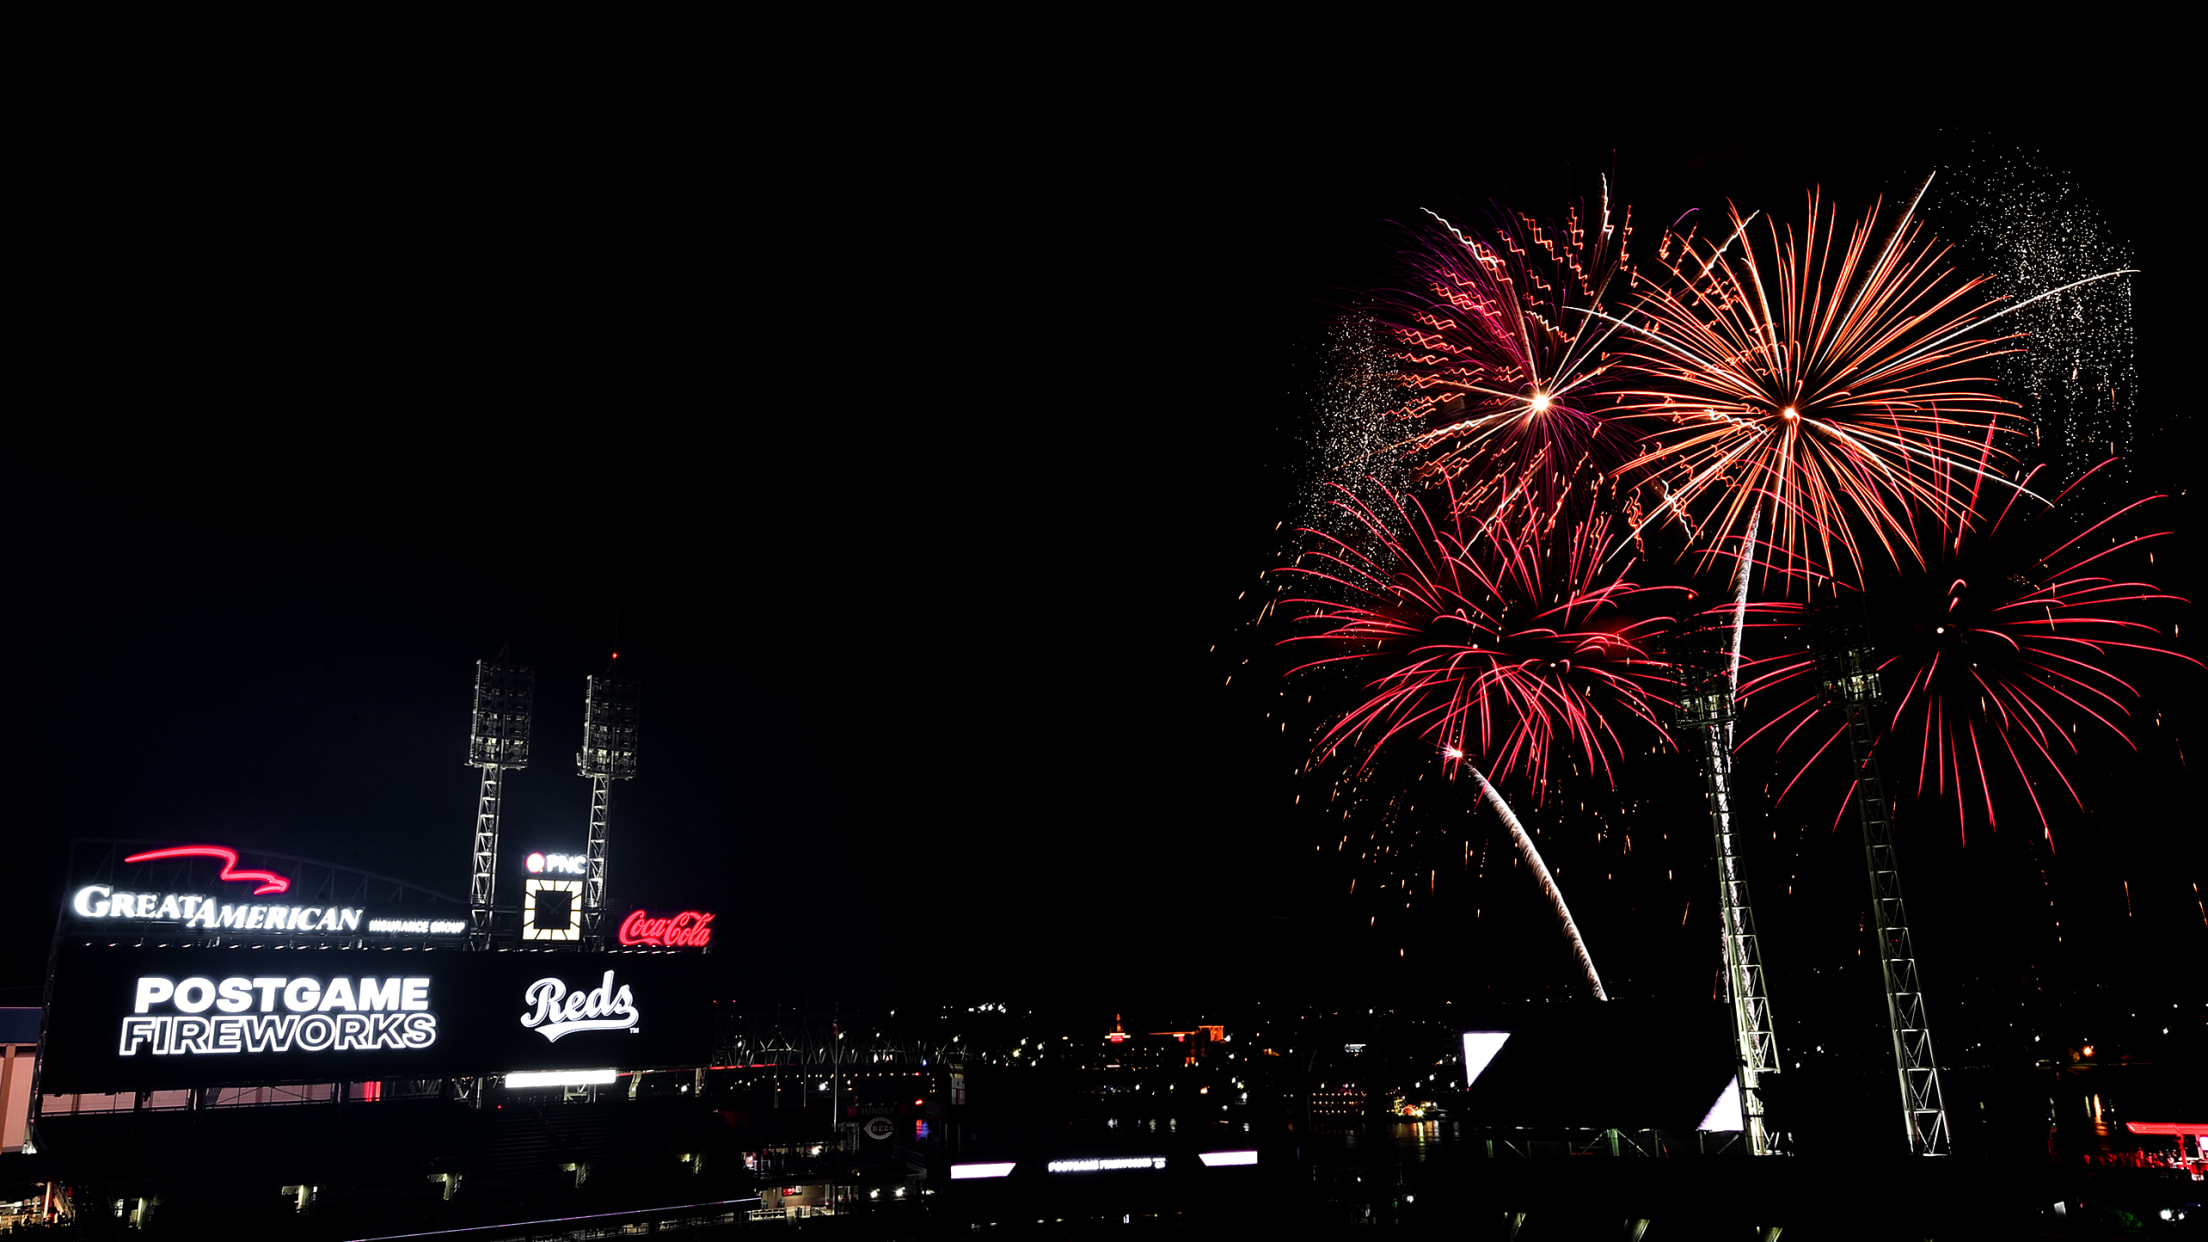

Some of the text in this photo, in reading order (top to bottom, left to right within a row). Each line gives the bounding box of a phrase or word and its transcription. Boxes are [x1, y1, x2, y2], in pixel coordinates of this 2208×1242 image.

[546, 854, 587, 874] PNC
[134, 977, 430, 1013] POSTGAME
[521, 970, 638, 1030] Reds
[119, 1013, 437, 1056] FIREWORKS
